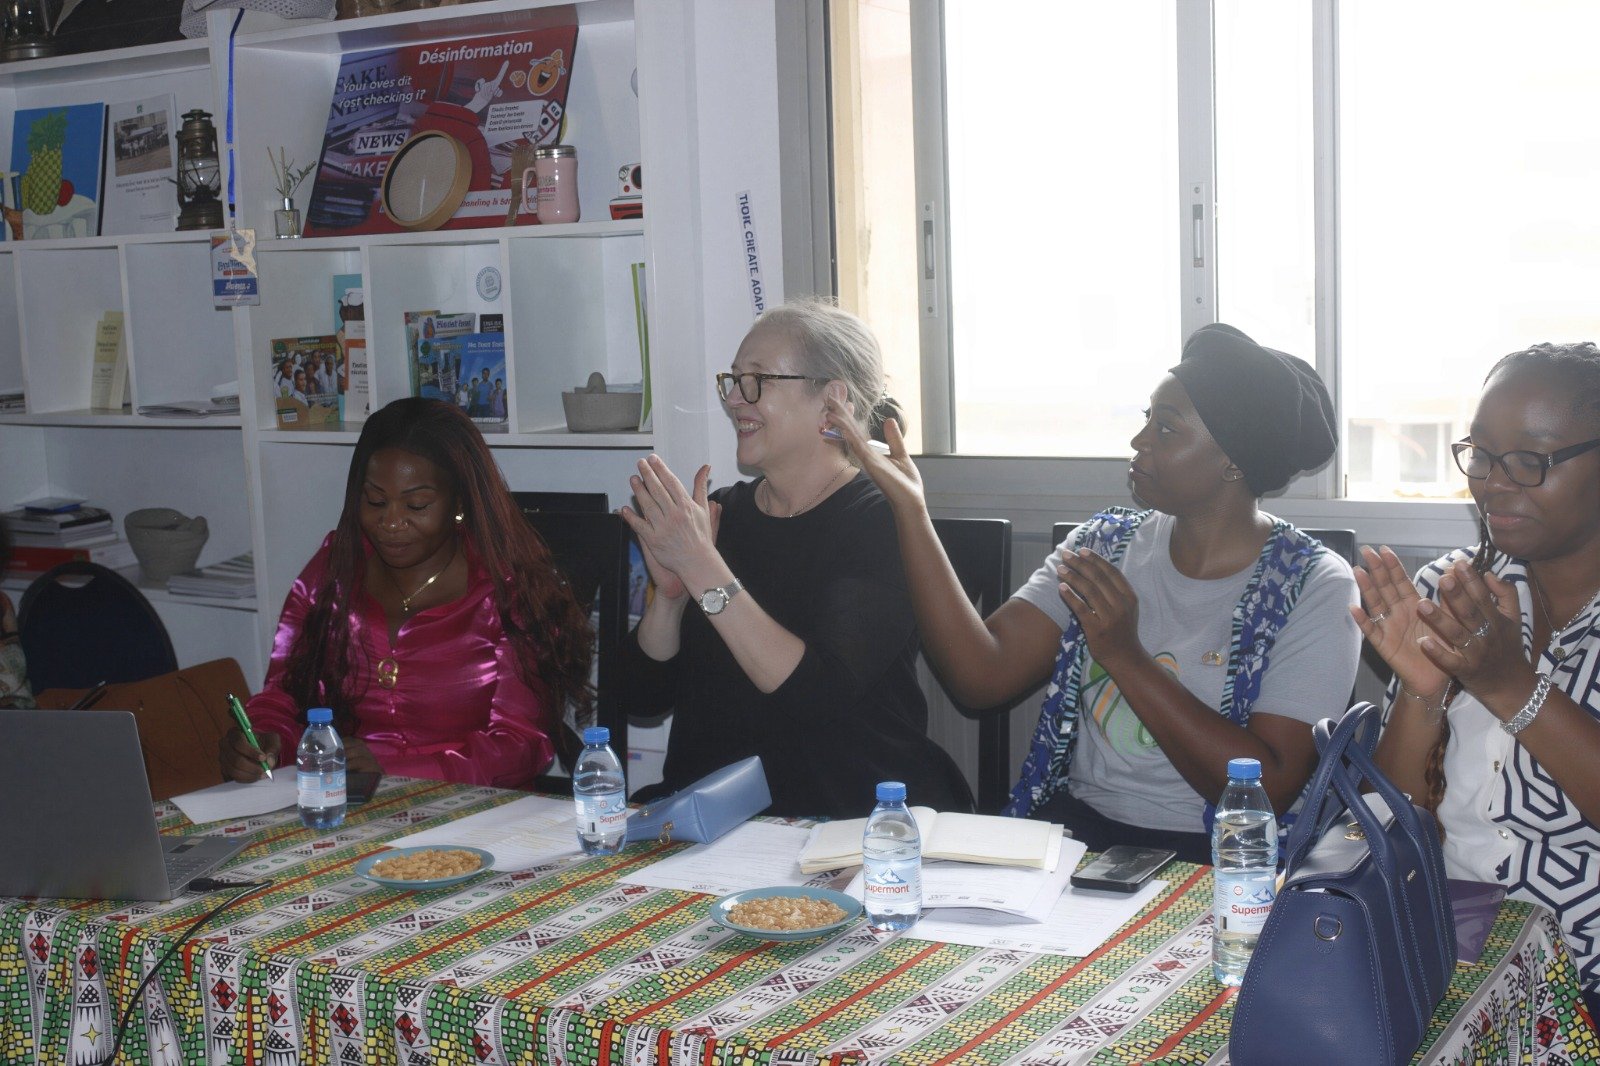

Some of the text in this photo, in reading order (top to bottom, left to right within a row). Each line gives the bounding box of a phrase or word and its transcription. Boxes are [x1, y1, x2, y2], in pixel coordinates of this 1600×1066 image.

[418, 40, 533, 65] Désinformation
[363, 91, 413, 106] checking
[356, 132, 406, 150] NEWS
[864, 880, 910, 894] Supermont
